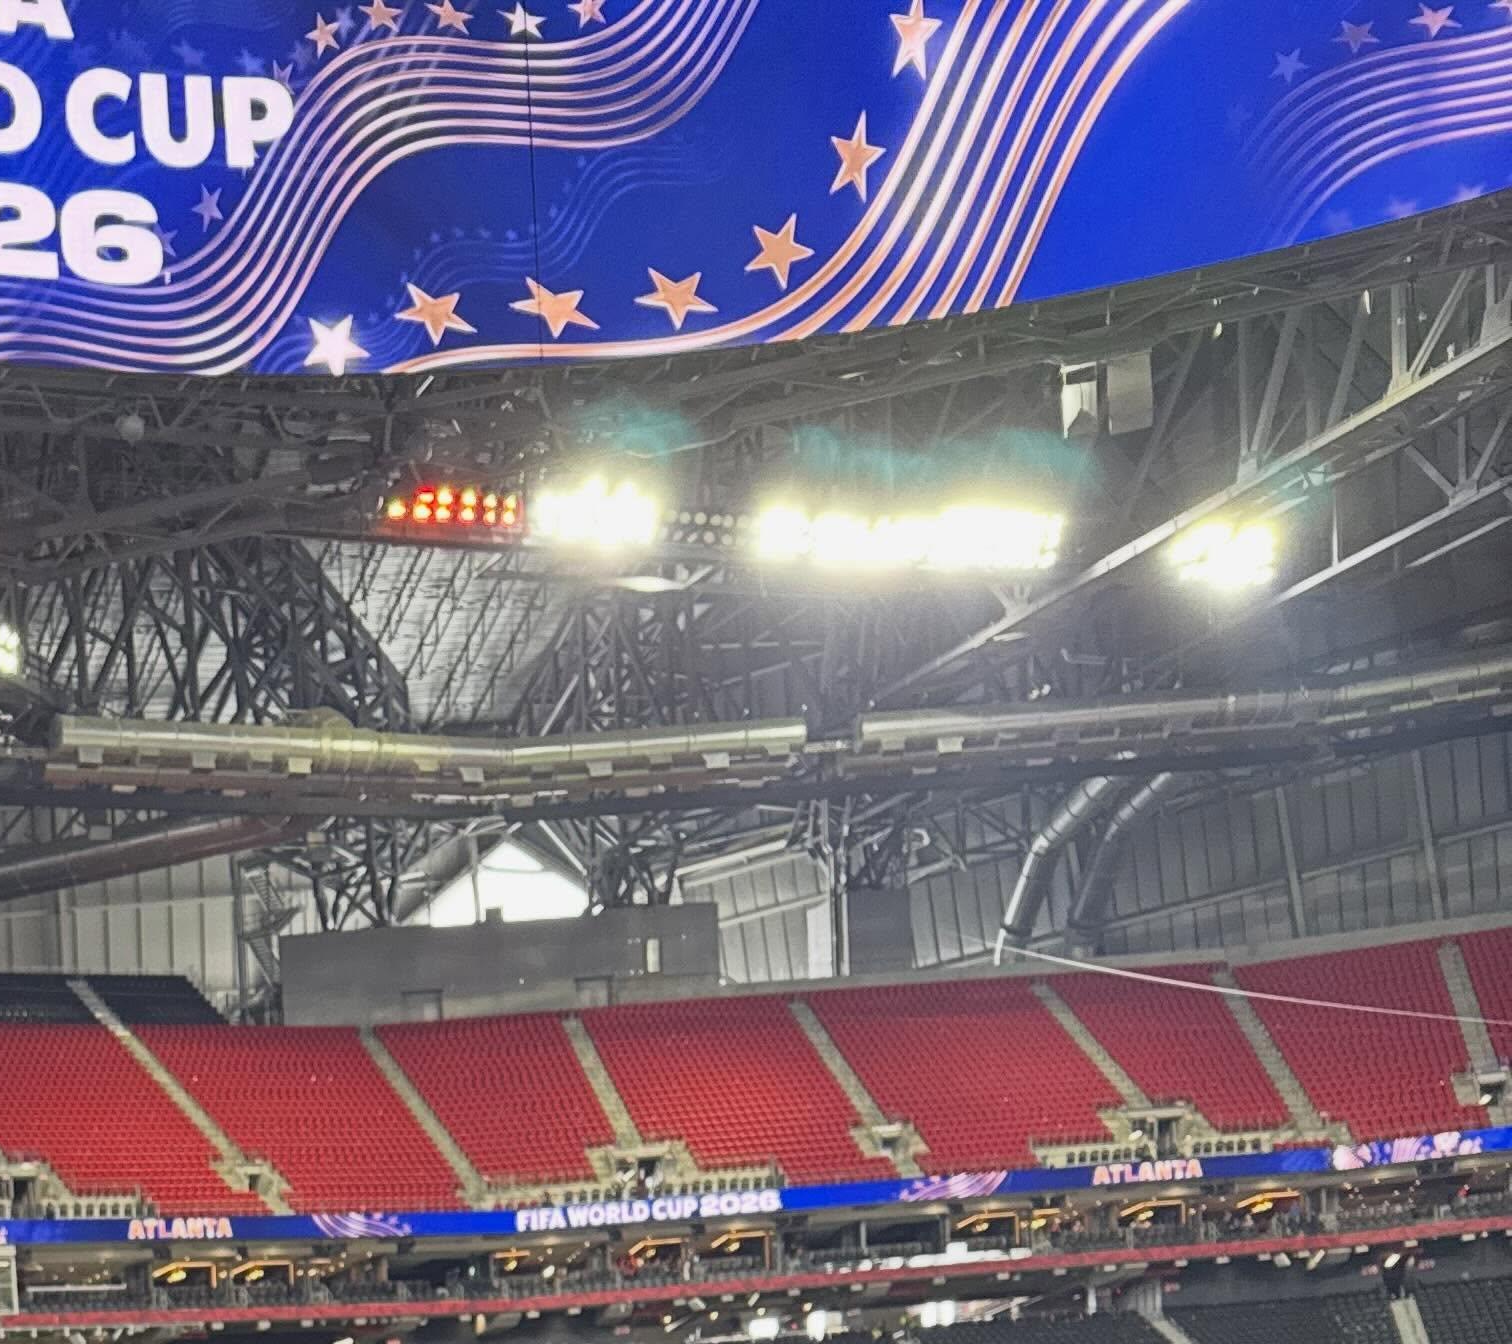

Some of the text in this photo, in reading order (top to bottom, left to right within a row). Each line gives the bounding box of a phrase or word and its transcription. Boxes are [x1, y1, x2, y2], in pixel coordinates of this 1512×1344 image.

[65, 67, 294, 169] CUP
[1093, 1159, 1203, 1184] ATLANTA
[516, 1190, 780, 1232] FIFA WORLD CUP 2026
[128, 1217, 233, 1240] ATLANTA
